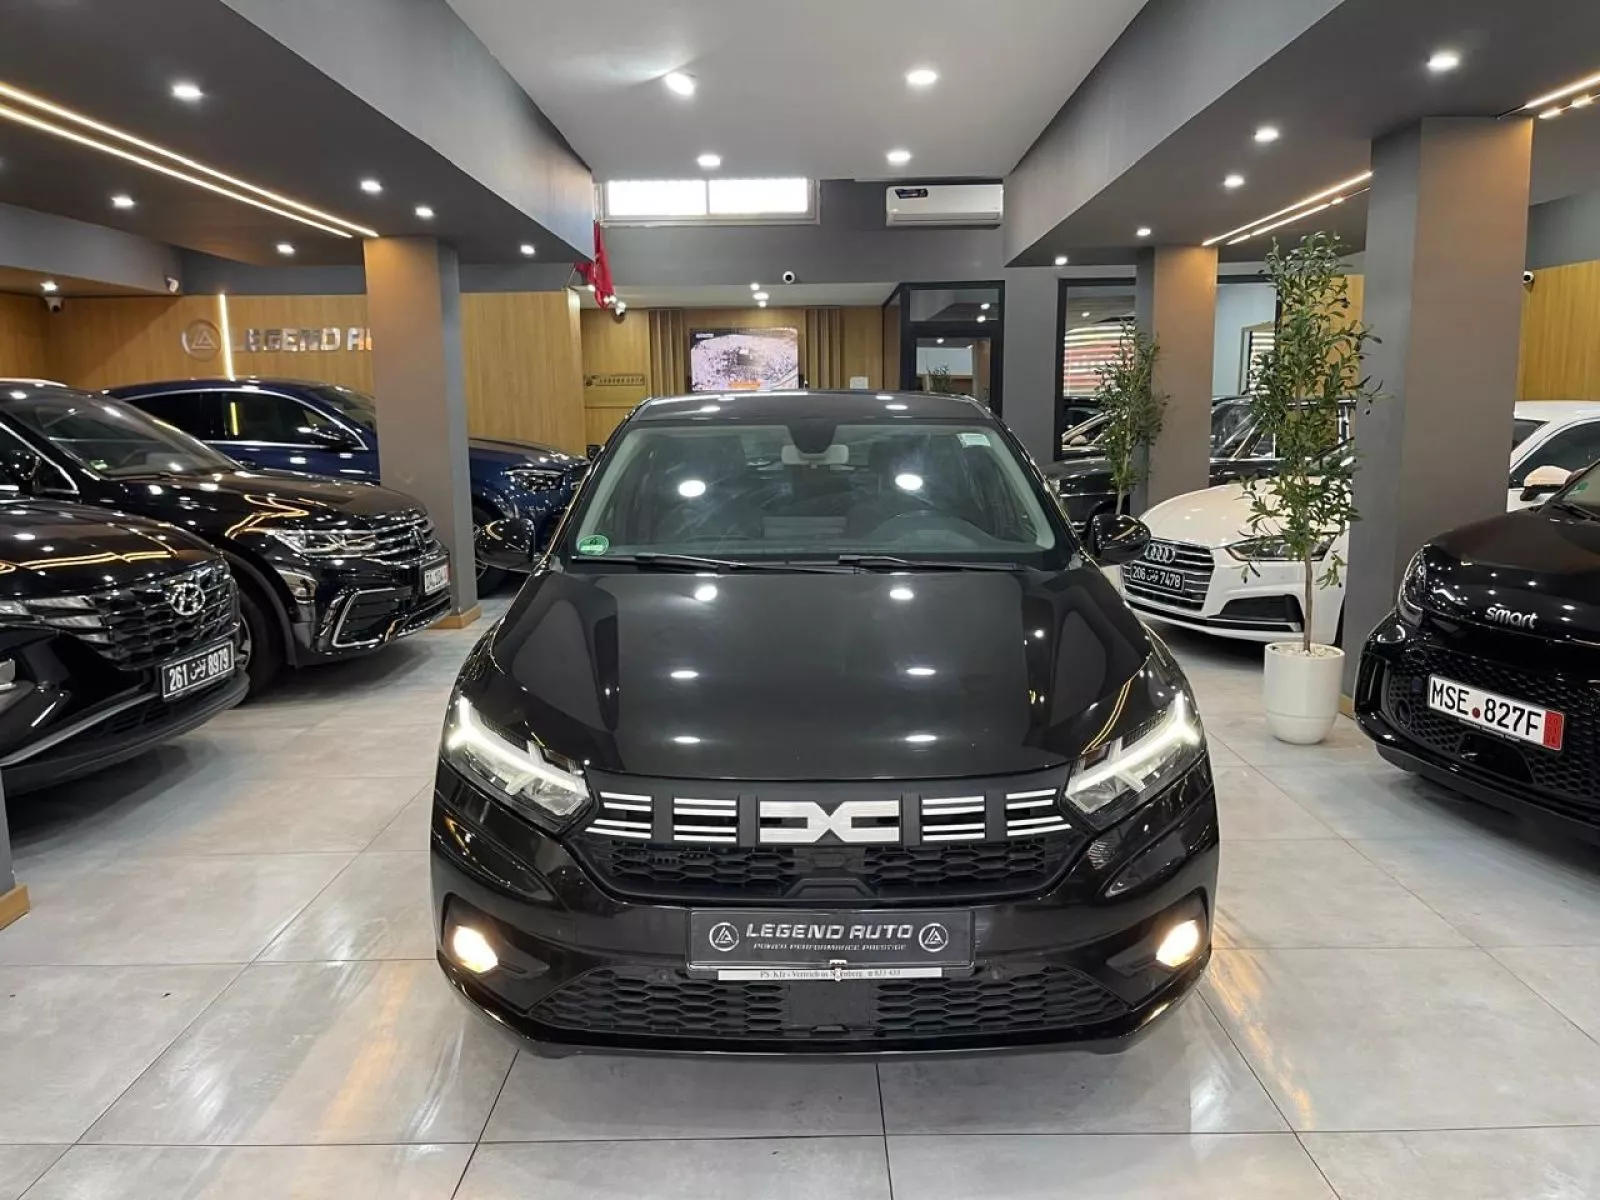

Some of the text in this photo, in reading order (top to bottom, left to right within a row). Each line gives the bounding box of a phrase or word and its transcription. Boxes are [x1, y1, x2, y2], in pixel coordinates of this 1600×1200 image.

[1134, 566, 1145, 580] 206
[1160, 571, 1180, 588] 7478
[1485, 606, 1538, 629] smart
[208, 648, 229, 675] 8979
[169, 664, 188, 691] 261
[1432, 679, 1470, 716] MSE
[1484, 698, 1542, 737] 827F
[746, 923, 913, 940] LEGEND AUTO
